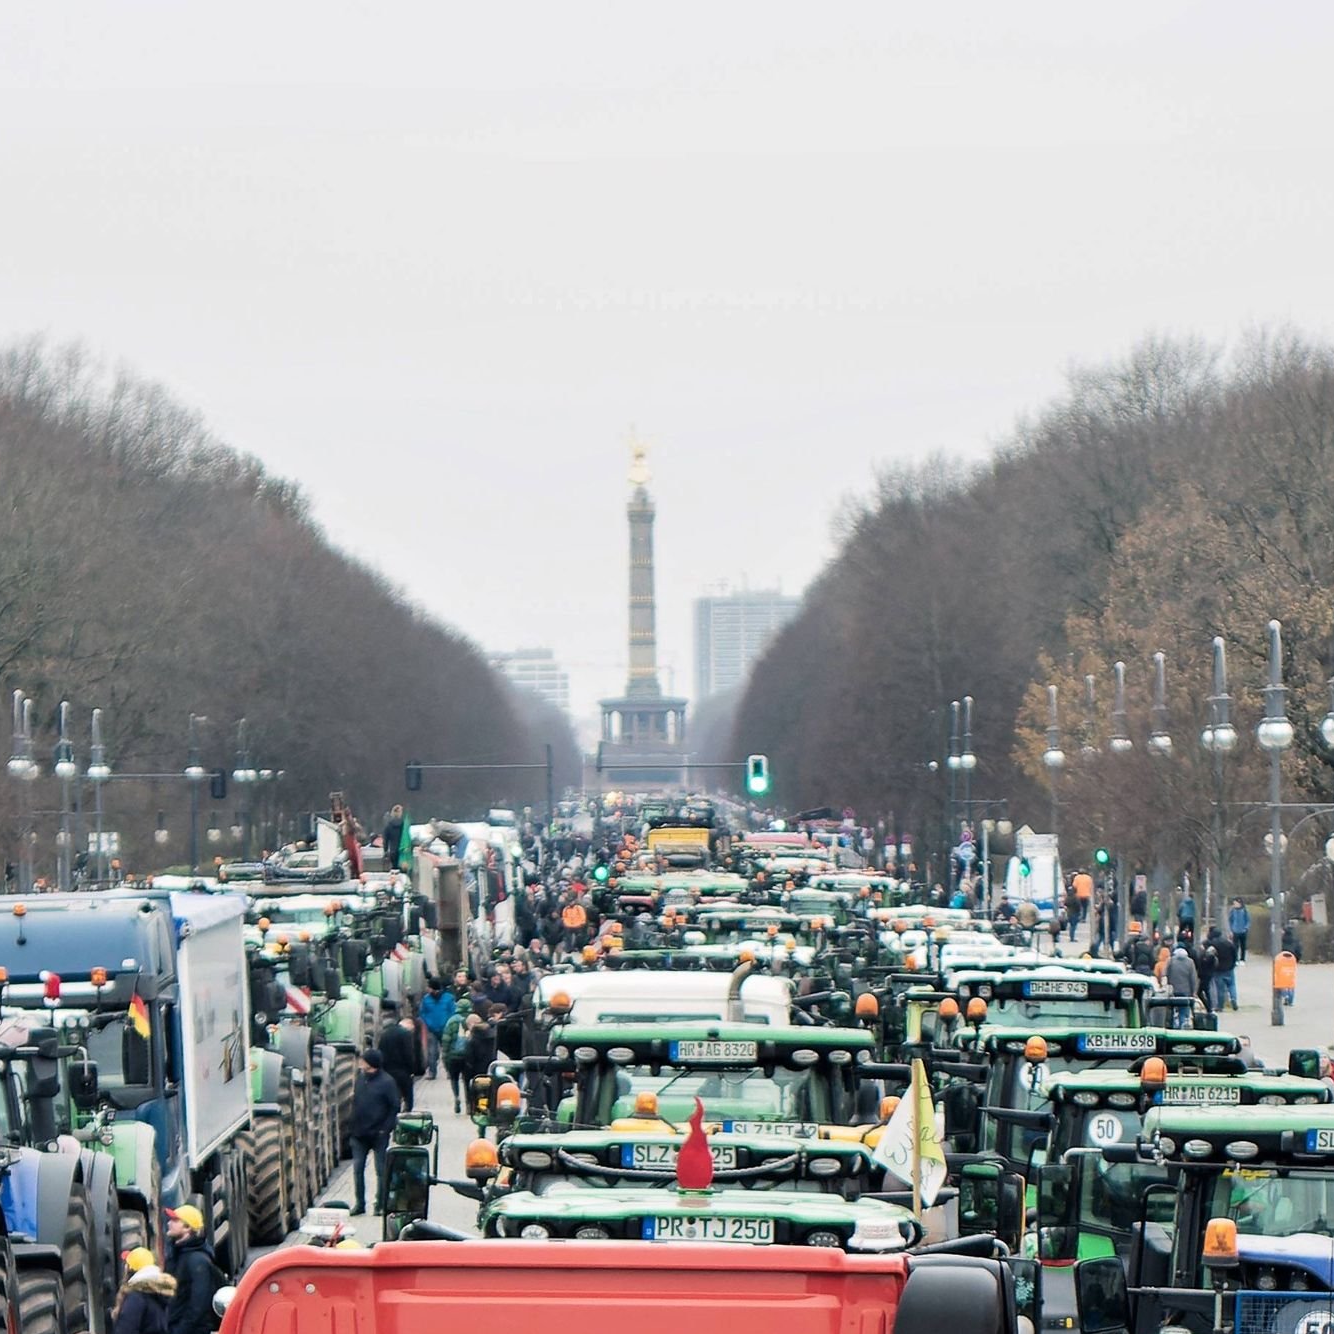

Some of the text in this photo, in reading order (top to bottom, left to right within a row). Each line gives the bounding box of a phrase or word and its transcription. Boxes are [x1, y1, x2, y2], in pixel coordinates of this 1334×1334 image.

[1031, 981, 1045, 993] DH
[1066, 982, 1088, 994] 943
[1086, 1034, 1155, 1048] KB HW 698
[679, 1042, 755, 1057] HR AG 8320
[1163, 1086, 1238, 1101] HR AG 6215
[1096, 1119, 1115, 1140] 50
[634, 1144, 670, 1164] SLZ
[656, 1217, 771, 1240] PR TJ 250
